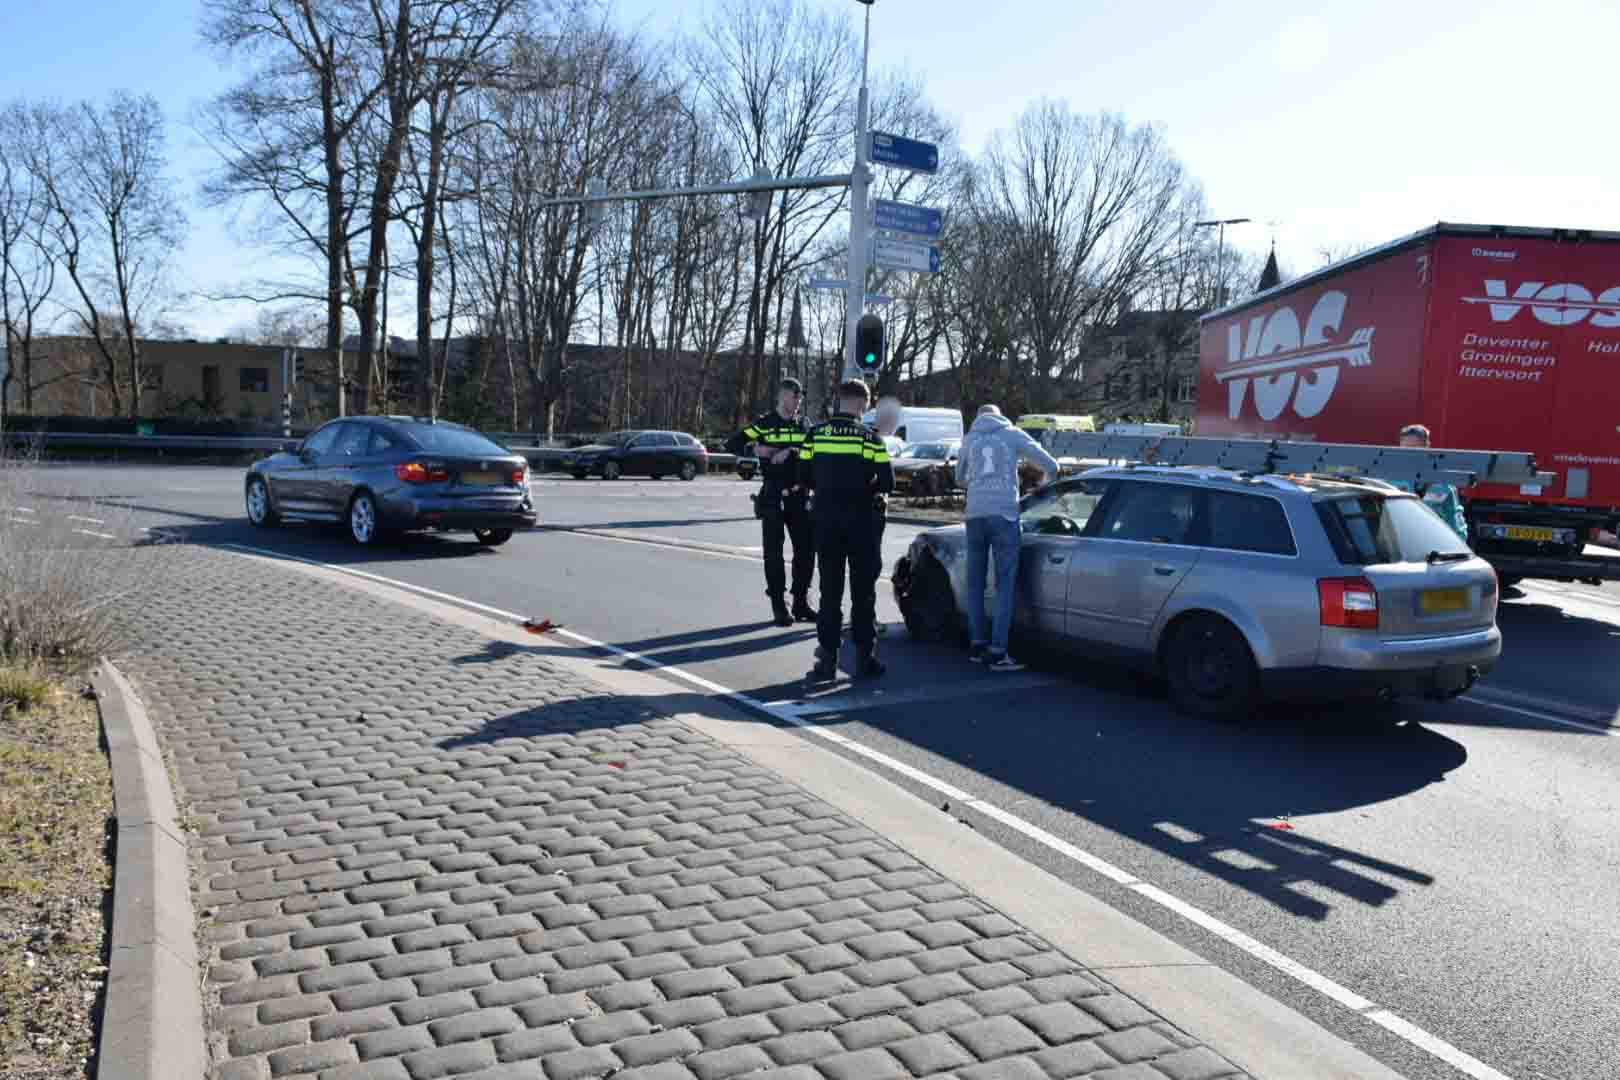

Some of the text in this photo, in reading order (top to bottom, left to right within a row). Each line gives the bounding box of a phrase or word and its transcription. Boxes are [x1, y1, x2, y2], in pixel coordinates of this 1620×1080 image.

[1484, 279, 1620, 328] VOS
[1228, 290, 1348, 421] VOS
[1463, 334, 1551, 349] Deventer
[1460, 350, 1556, 368] Groningen
